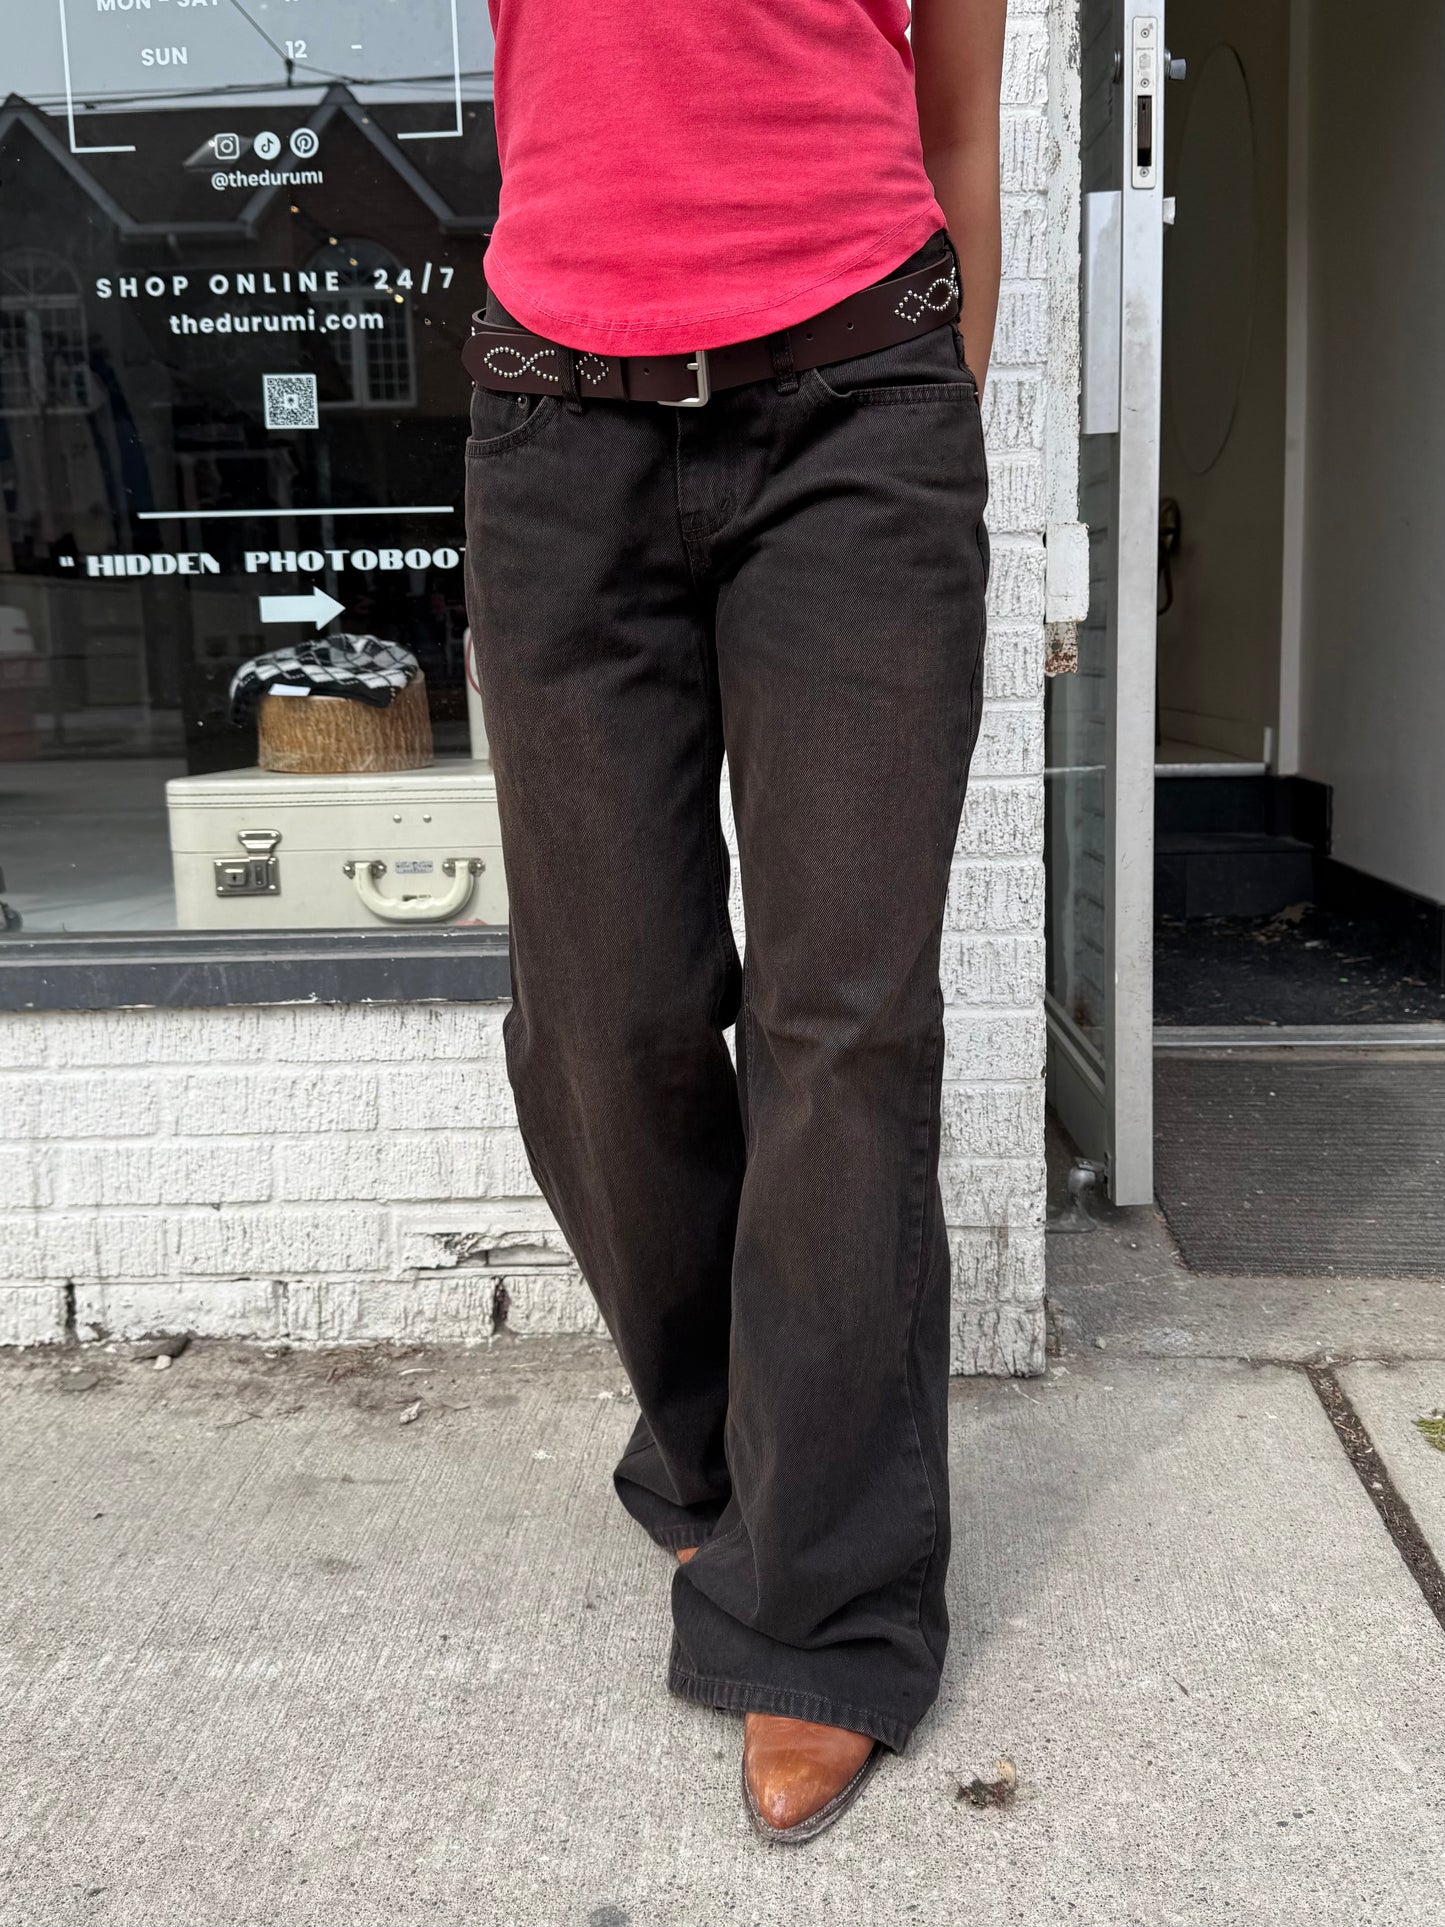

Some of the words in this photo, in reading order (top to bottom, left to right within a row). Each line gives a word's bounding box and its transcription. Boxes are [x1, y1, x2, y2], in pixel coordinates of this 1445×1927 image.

[141, 46, 188, 67] SUN
[285, 40, 308, 59] 12
[211, 169, 324, 191] @thedurumi
[96, 275, 189, 298] SHOP
[209, 271, 340, 295] ONLINE
[373, 262, 454, 294] 24/7
[169, 308, 384, 335] thedurumi.com
[245, 547, 465, 573] PHOTOBOO
